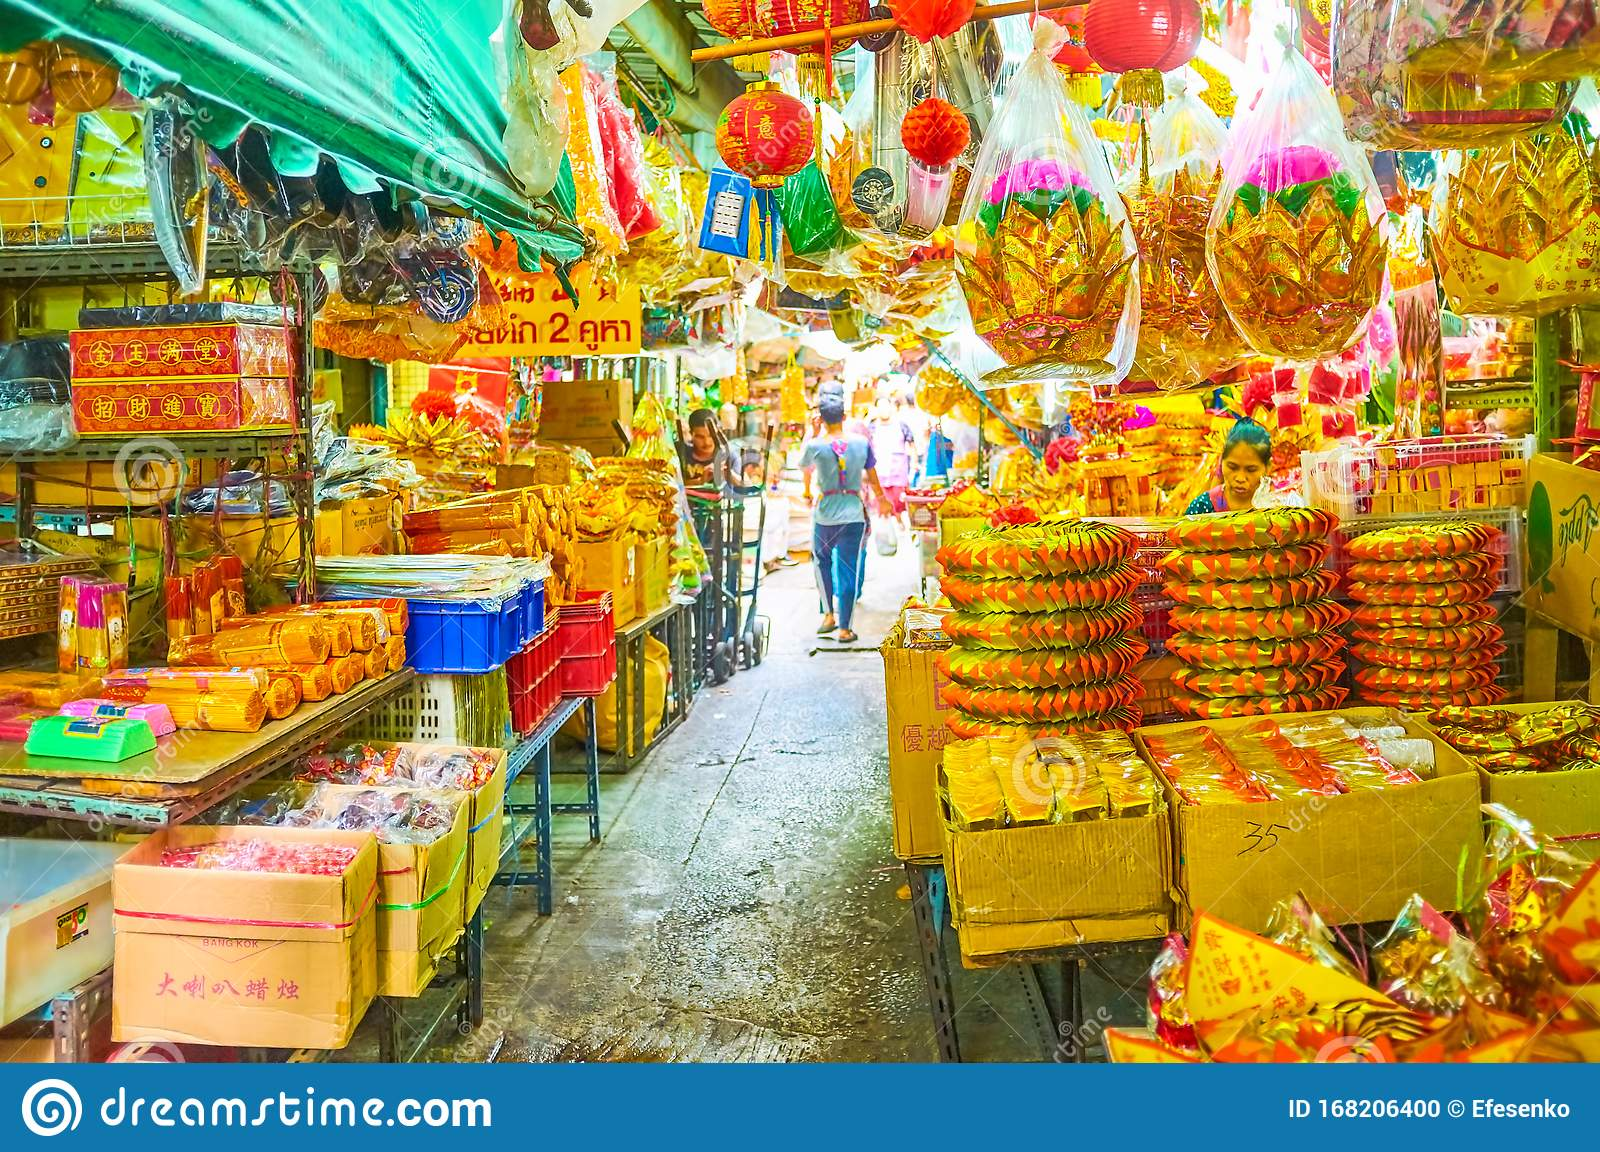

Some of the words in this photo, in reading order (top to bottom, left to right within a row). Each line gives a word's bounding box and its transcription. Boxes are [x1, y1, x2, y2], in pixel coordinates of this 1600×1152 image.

[550, 312, 570, 343] 2
[579, 319, 632, 350] คูหา
[1237, 821, 1291, 856] 35
